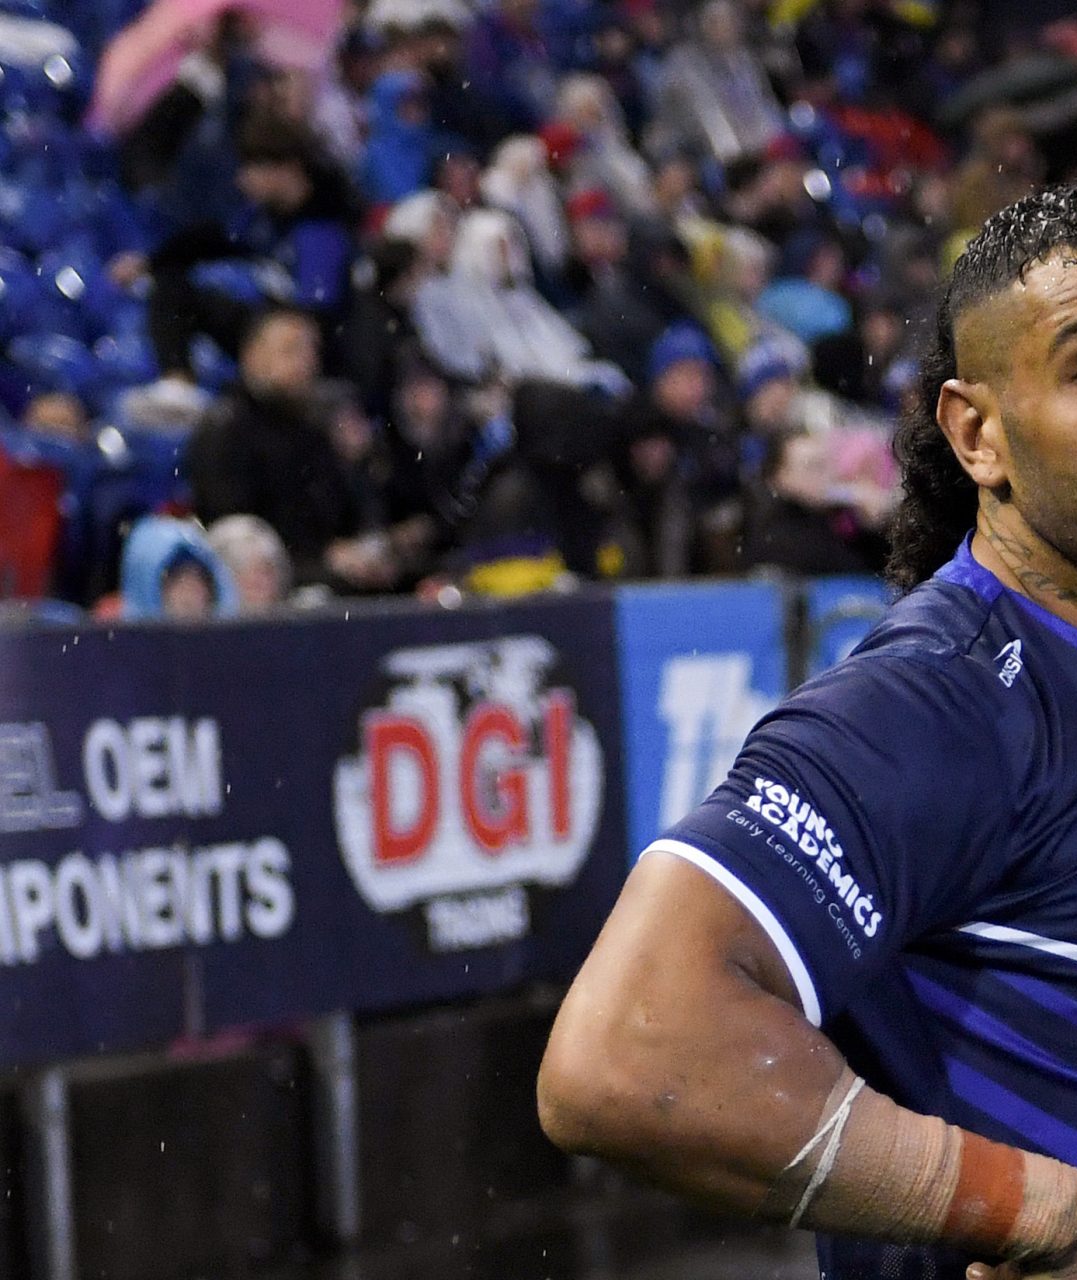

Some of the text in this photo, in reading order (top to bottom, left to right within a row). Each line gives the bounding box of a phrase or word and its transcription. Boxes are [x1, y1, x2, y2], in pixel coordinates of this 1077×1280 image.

[82, 714, 223, 822] OEM
[365, 688, 575, 870] DGI
[0, 833, 295, 967] PONENTS
[726, 809, 861, 960] Early Learning Centre
[746, 795, 882, 938] ACADEMICS
